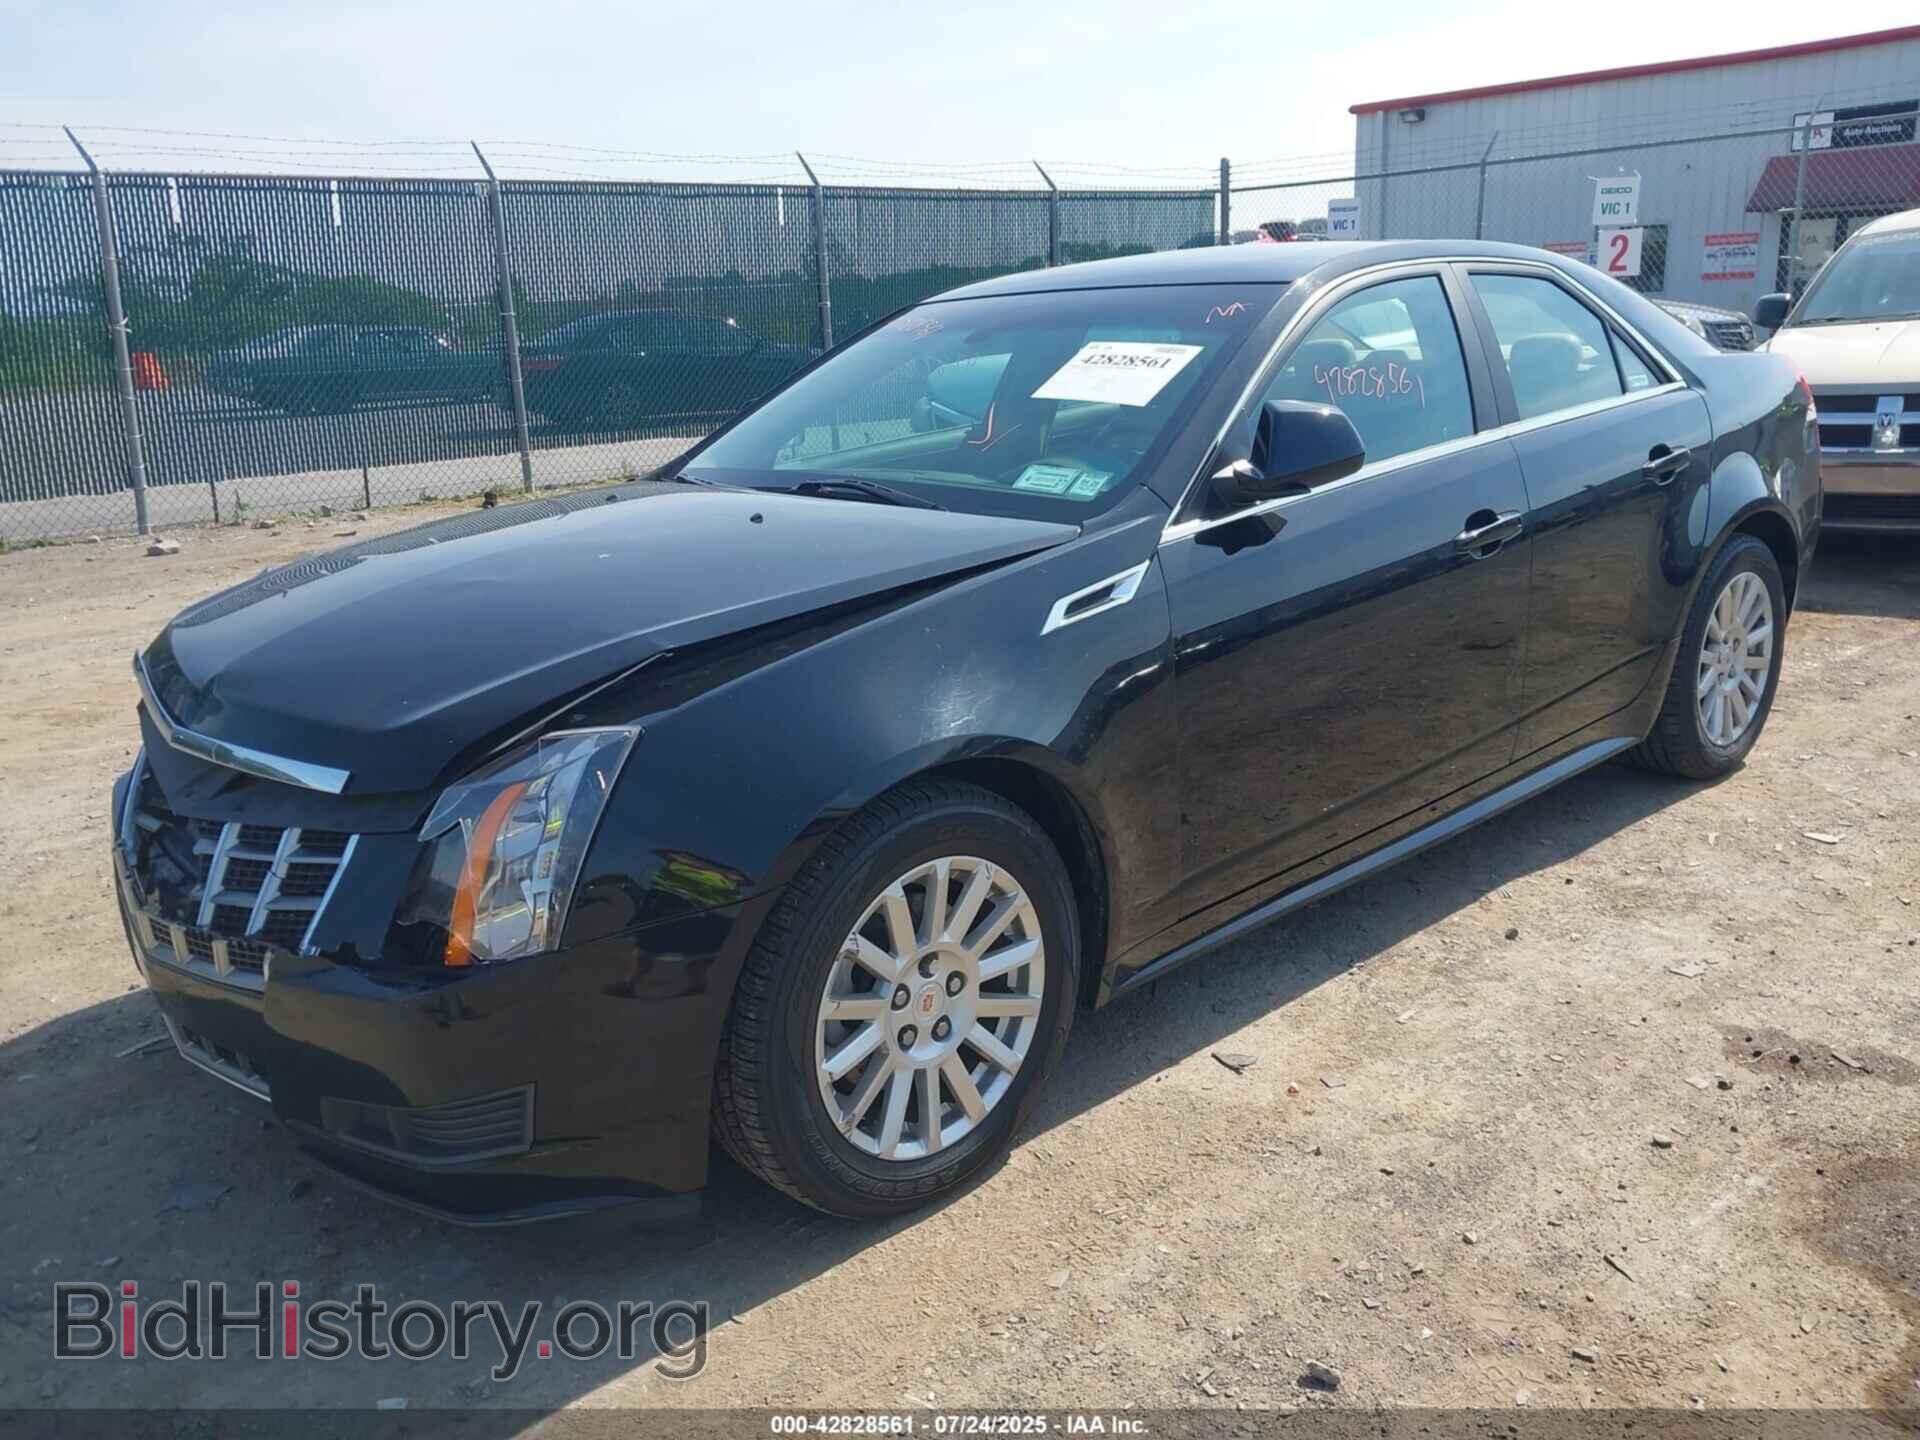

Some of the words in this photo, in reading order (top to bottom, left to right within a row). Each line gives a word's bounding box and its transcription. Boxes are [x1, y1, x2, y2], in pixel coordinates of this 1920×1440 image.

[1601, 202, 1620, 215] VIC
[1625, 202, 1631, 214] 1
[1333, 219, 1348, 231] VIC
[1351, 219, 1356, 230] 1
[1608, 234, 1629, 272] 2
[1081, 353, 1173, 370] 42828561
